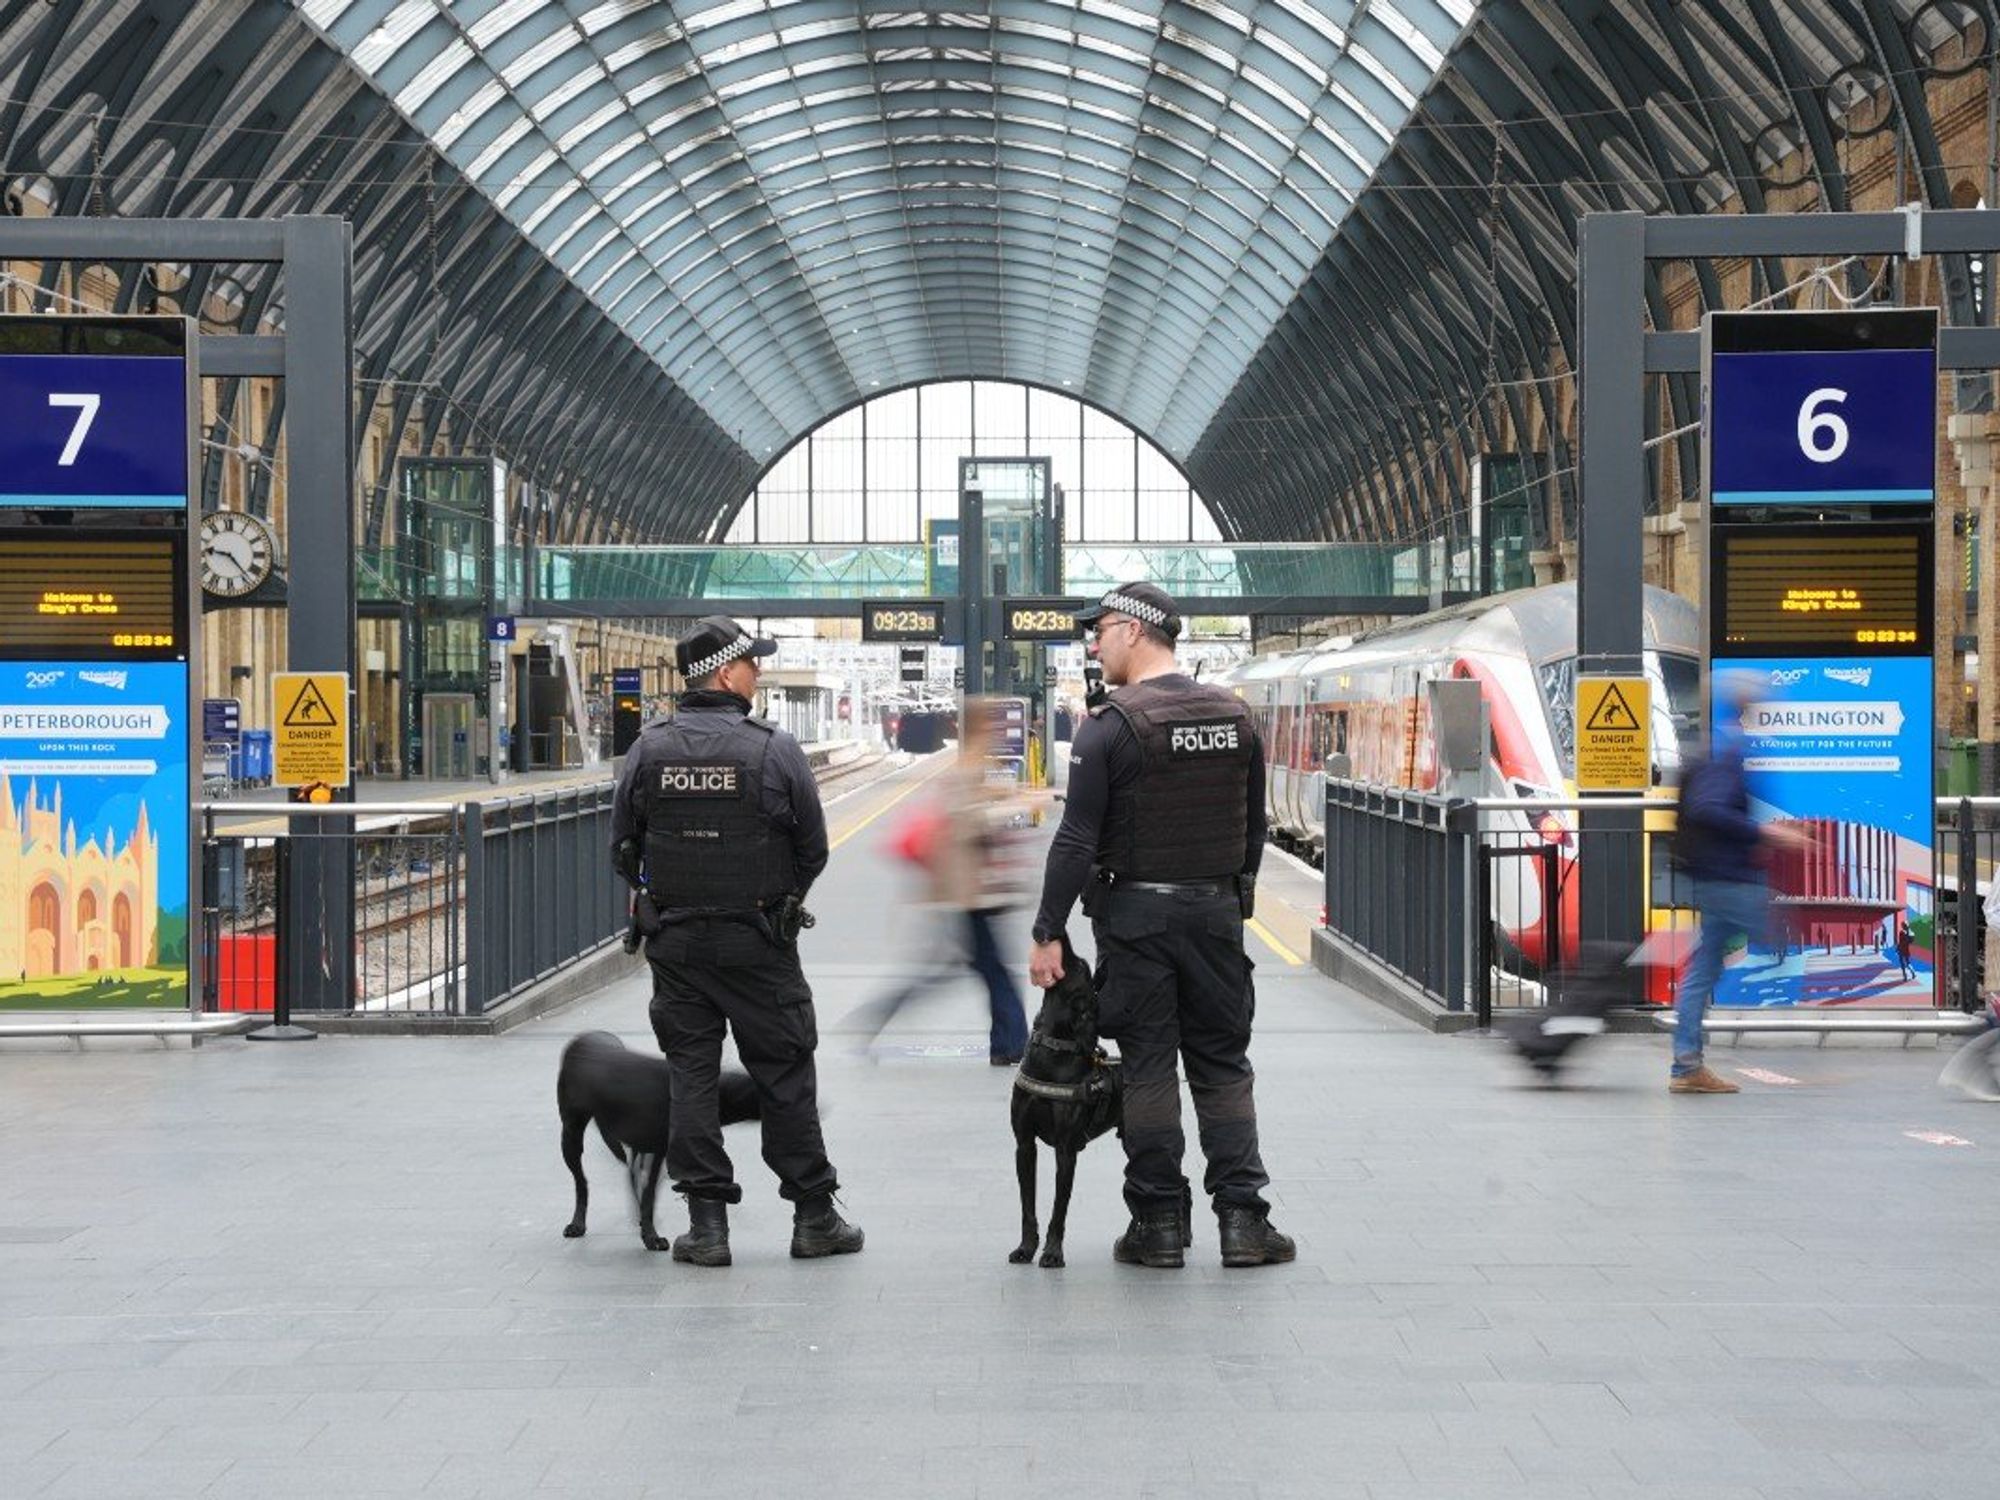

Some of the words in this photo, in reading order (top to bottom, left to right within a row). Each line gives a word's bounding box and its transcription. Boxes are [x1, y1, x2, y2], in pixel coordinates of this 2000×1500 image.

[48, 393, 101, 466] 7
[1797, 387, 1849, 463] 6
[44, 592, 93, 603] Welcome
[97, 593, 114, 603] to
[1787, 589, 1837, 599] Welcome
[1842, 588, 1857, 599] to
[39, 603, 77, 614] King's
[81, 603, 118, 613] Cross
[1782, 600, 1820, 613] King's
[1825, 600, 1861, 610] Cross
[496, 621, 508, 637] 8
[2, 713, 152, 729] PETERBOROUGH
[1758, 711, 1885, 726] DARLINGTON
[288, 730, 332, 740] DANGER
[1171, 731, 1239, 752] POLICE
[1590, 734, 1635, 744] DANGER
[39, 743, 65, 752] UPON
[67, 743, 89, 752] THIS
[1759, 740, 1797, 749] STATION
[1838, 740, 1855, 749] THE
[1857, 740, 1893, 749] FUTURE
[661, 773, 737, 791] POLICE
